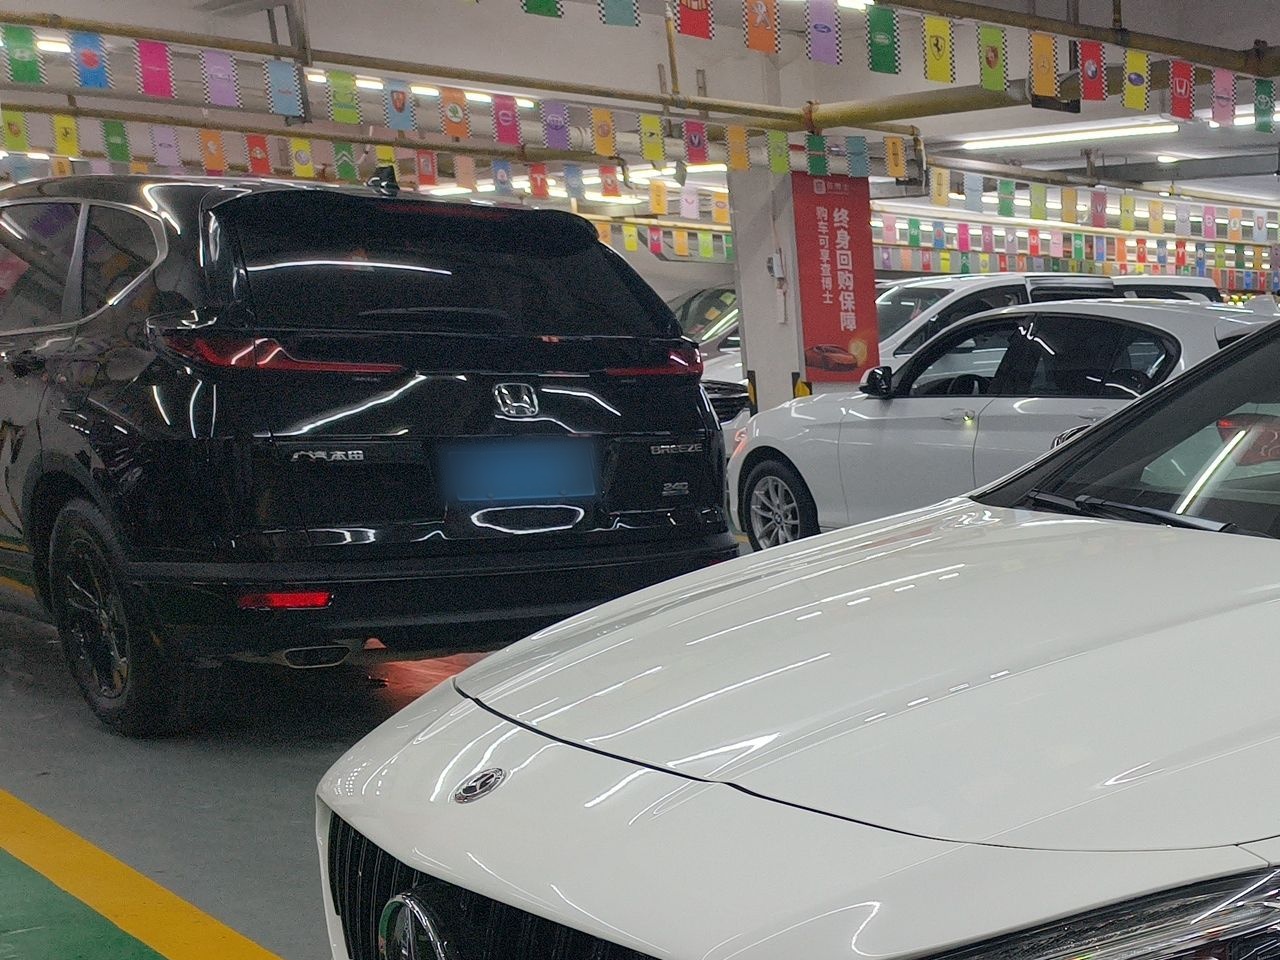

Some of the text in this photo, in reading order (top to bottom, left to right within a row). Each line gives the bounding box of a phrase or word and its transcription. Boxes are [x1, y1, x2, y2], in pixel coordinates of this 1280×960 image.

[816, 206, 834, 304] 购车可享查博士
[833, 207, 857, 331] 终身回购保障
[650, 443, 703, 454] BREEZE
